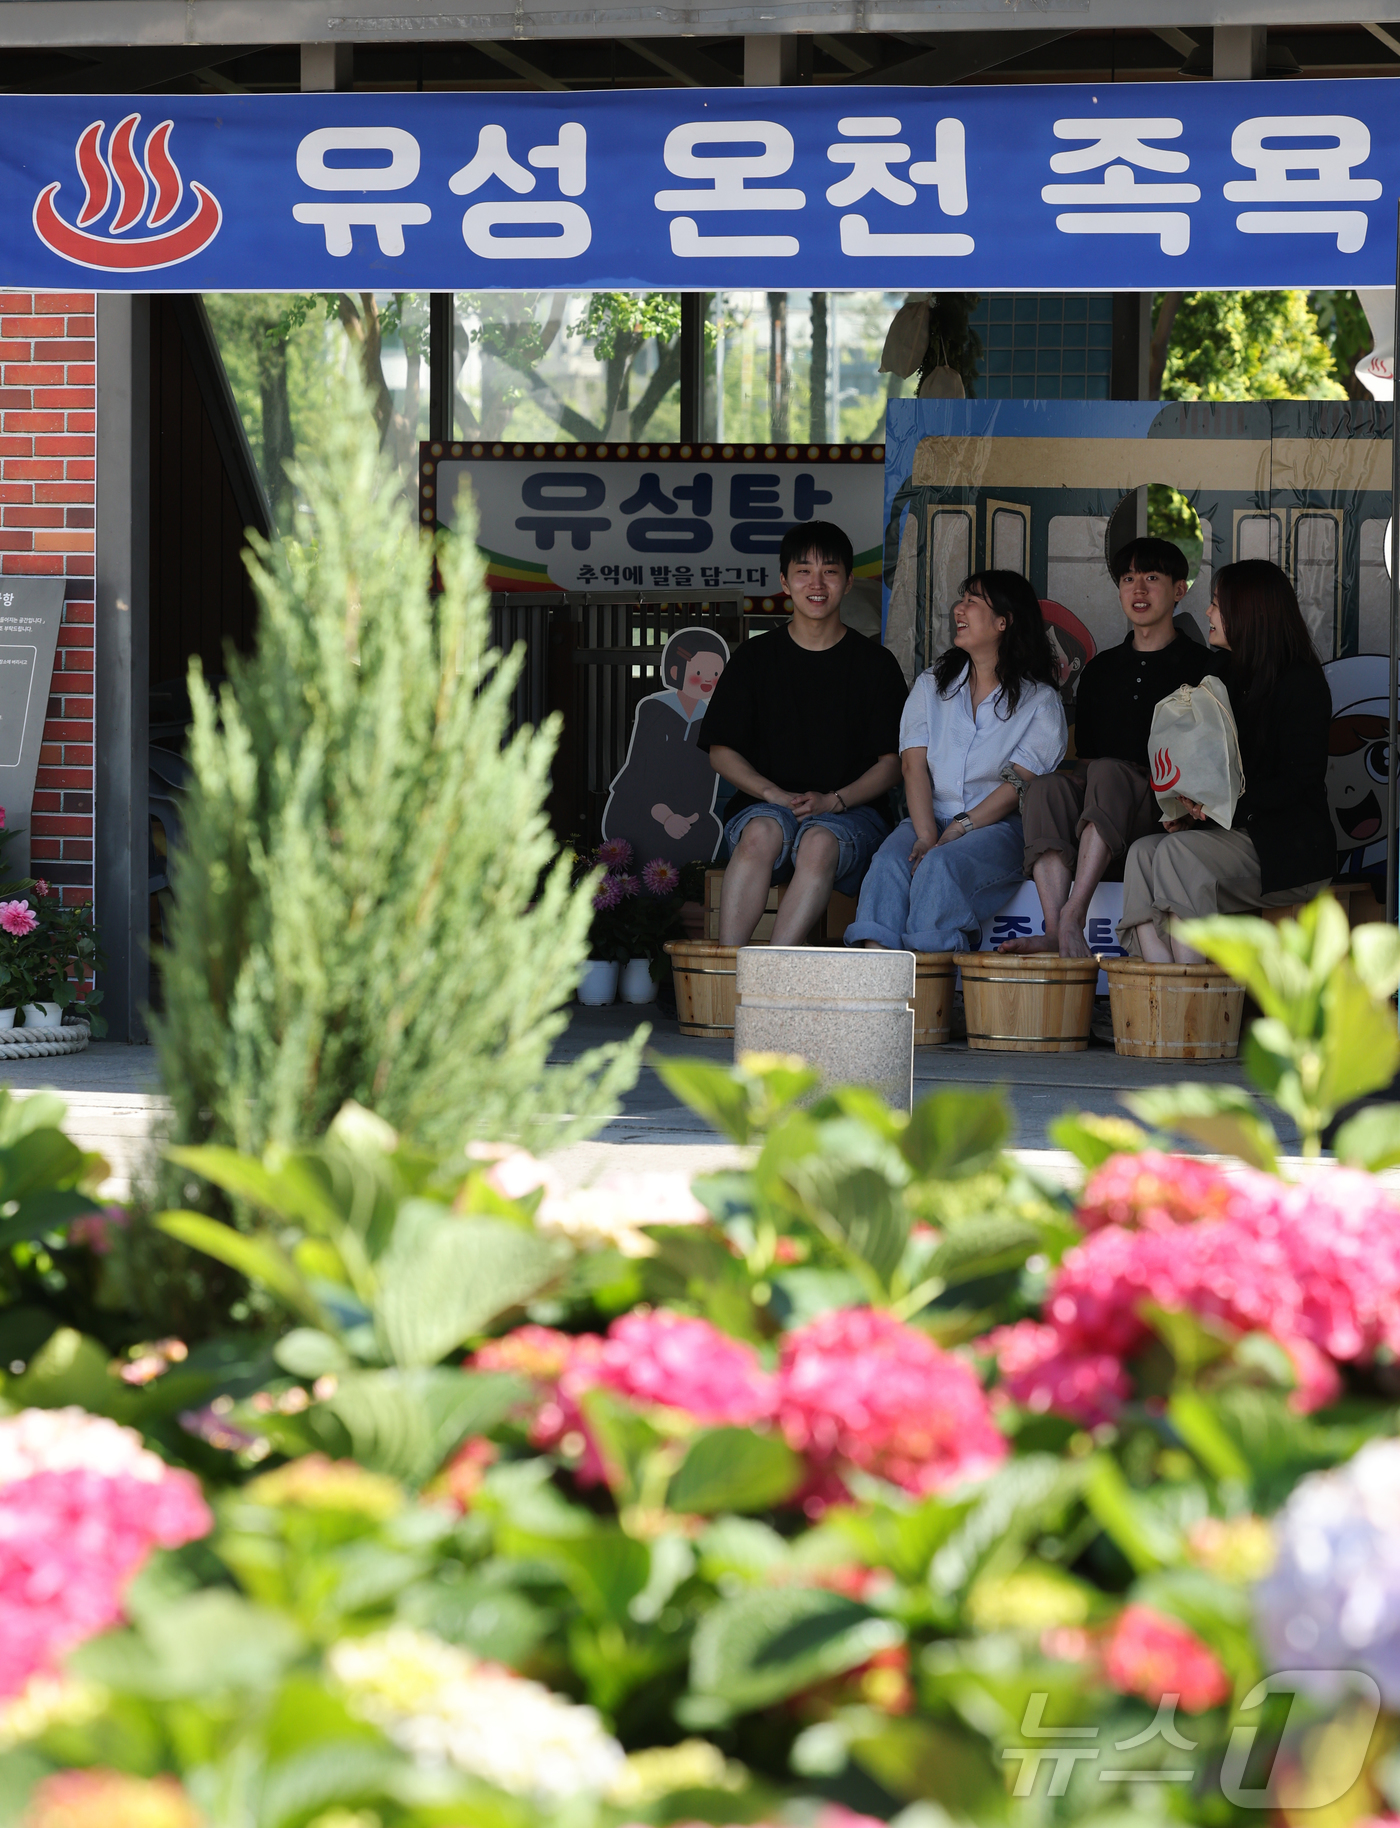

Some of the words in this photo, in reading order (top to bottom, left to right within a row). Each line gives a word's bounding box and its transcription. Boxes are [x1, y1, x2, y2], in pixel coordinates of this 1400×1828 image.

[292, 121, 592, 259] 유성
[654, 116, 976, 258] 온천
[1041, 115, 1384, 257] 족욕
[514, 471, 833, 555] 유성탕
[0, 592, 14, 607] 항
[576, 564, 644, 586] 추억에
[649, 565, 694, 587] 발을
[700, 566, 769, 588] 담그다
